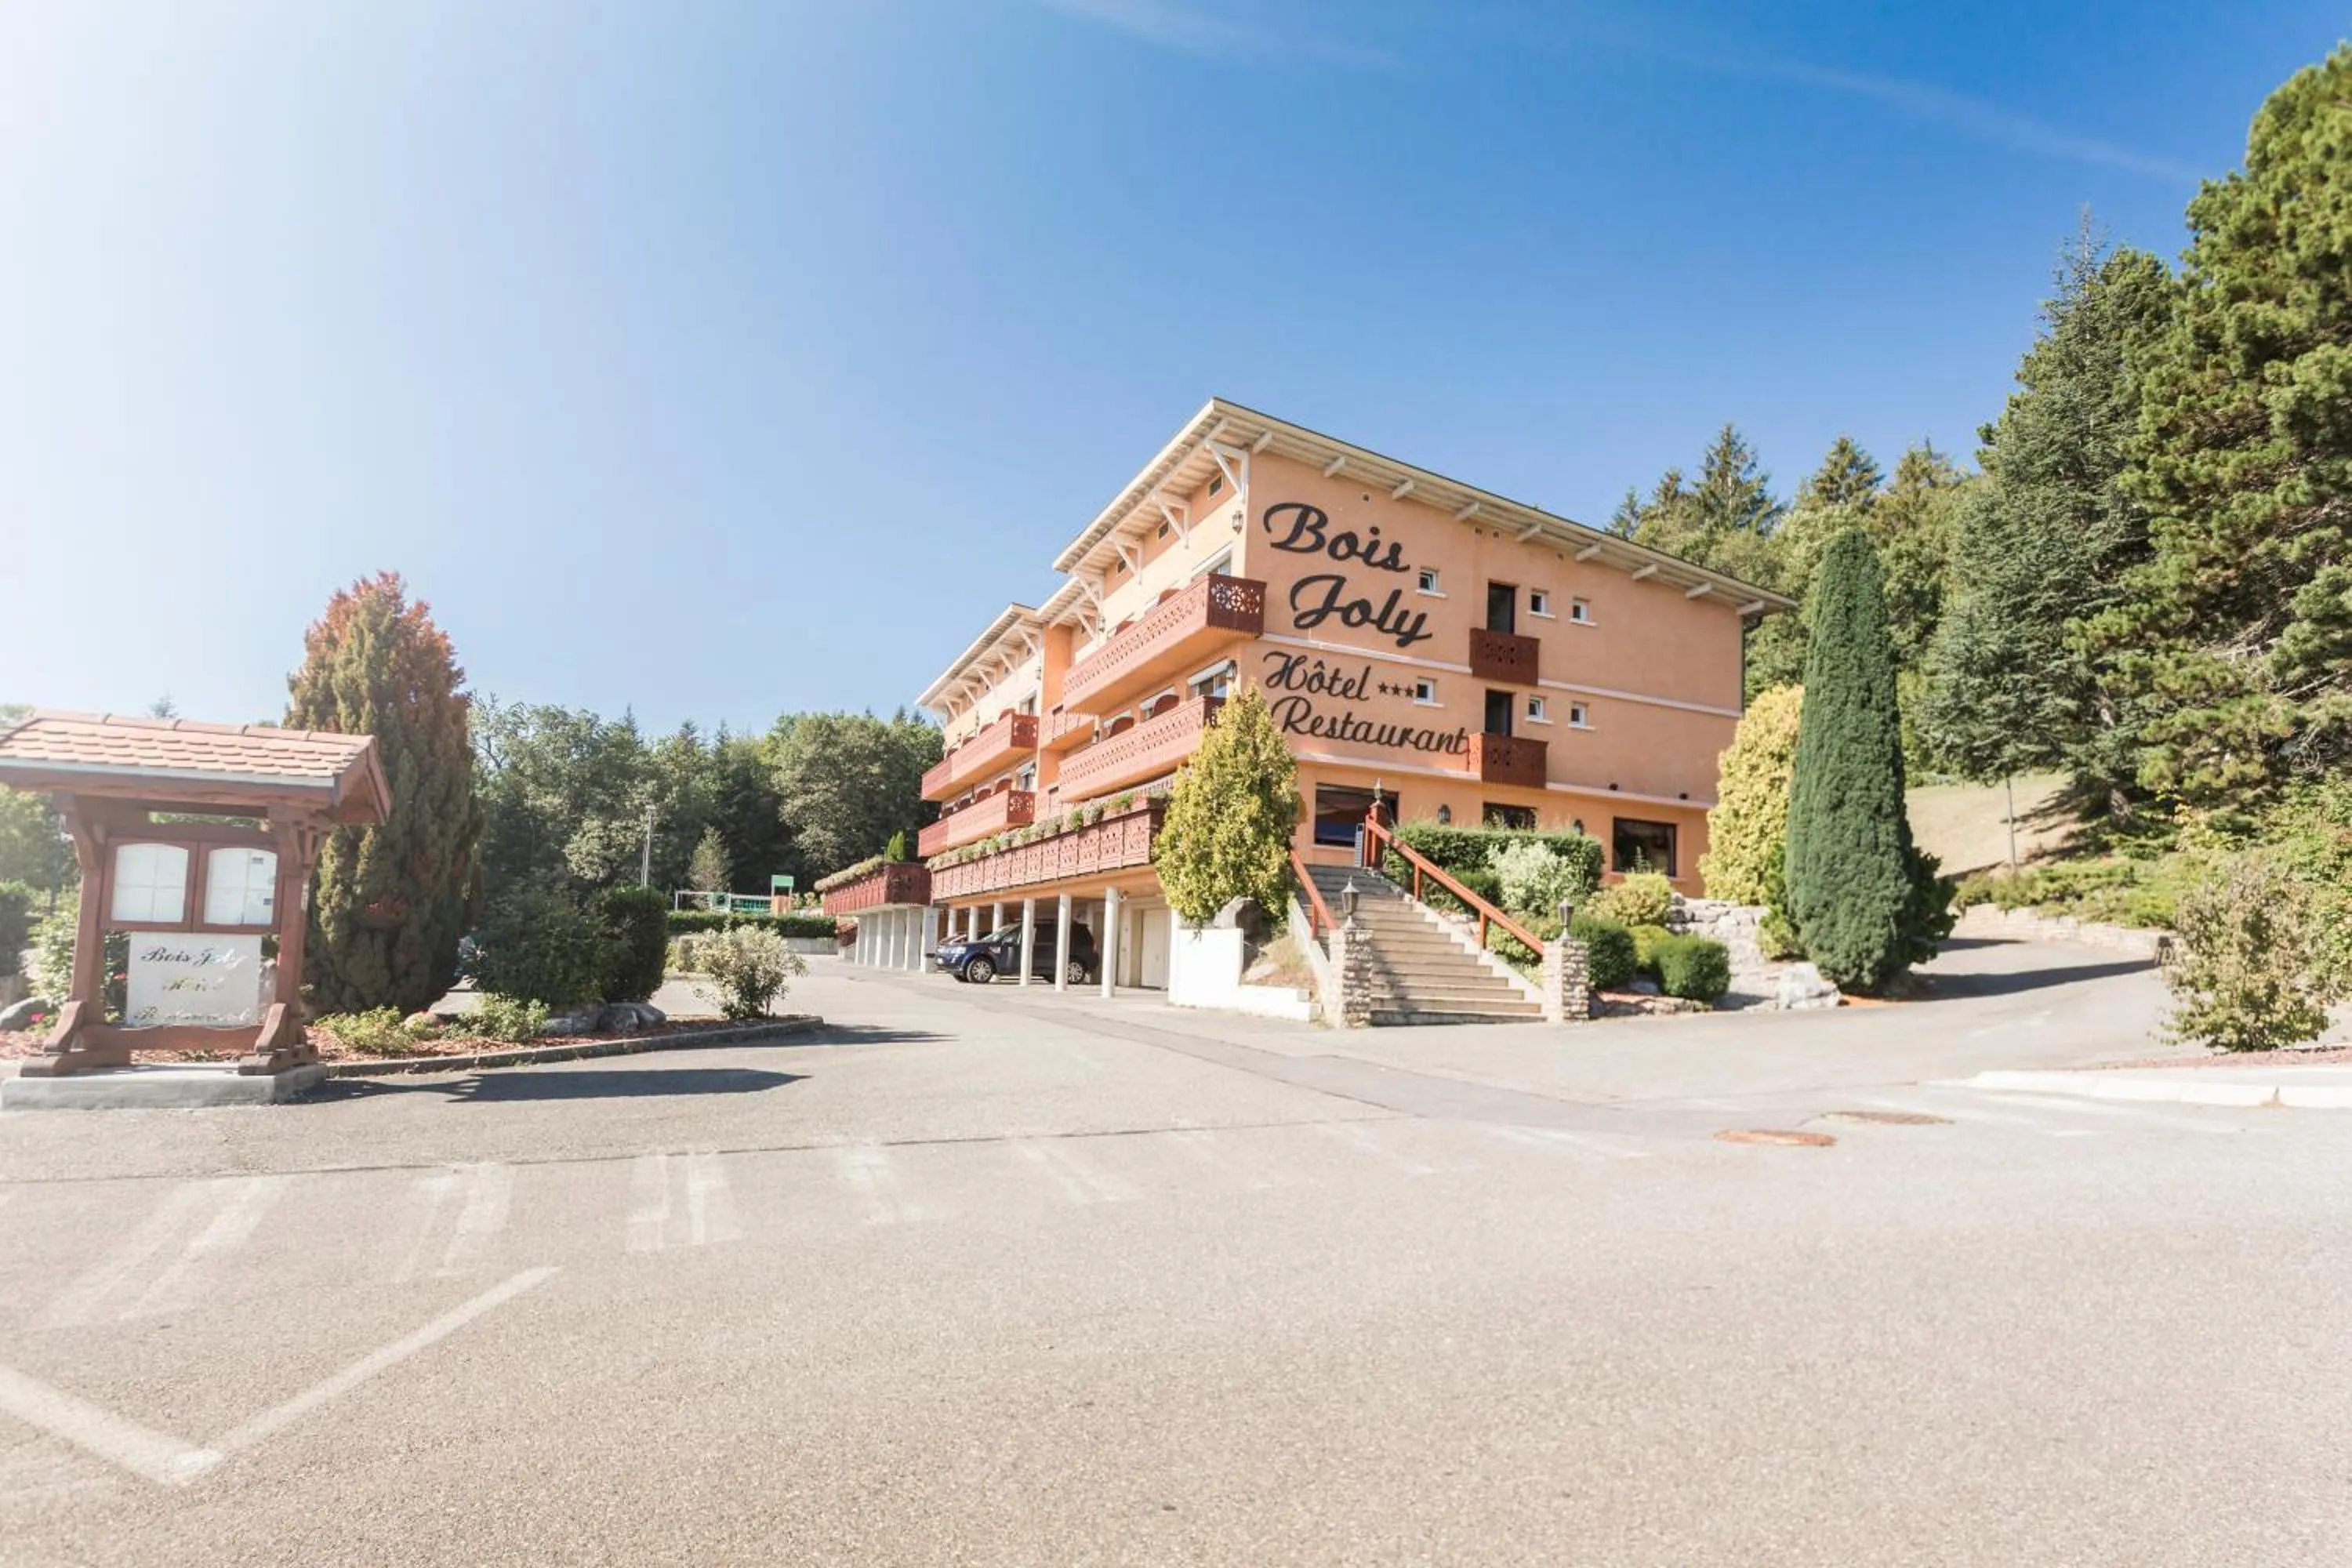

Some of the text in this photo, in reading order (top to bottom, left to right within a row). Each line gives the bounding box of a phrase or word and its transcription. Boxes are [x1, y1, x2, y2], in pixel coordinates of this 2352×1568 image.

[1263, 502, 1410, 572] Bois
[1290, 575, 1433, 648] Joly
[1263, 651, 1371, 701] Hôtel
[1271, 695, 1471, 755] Restaurant
[140, 946, 191, 963] Bois
